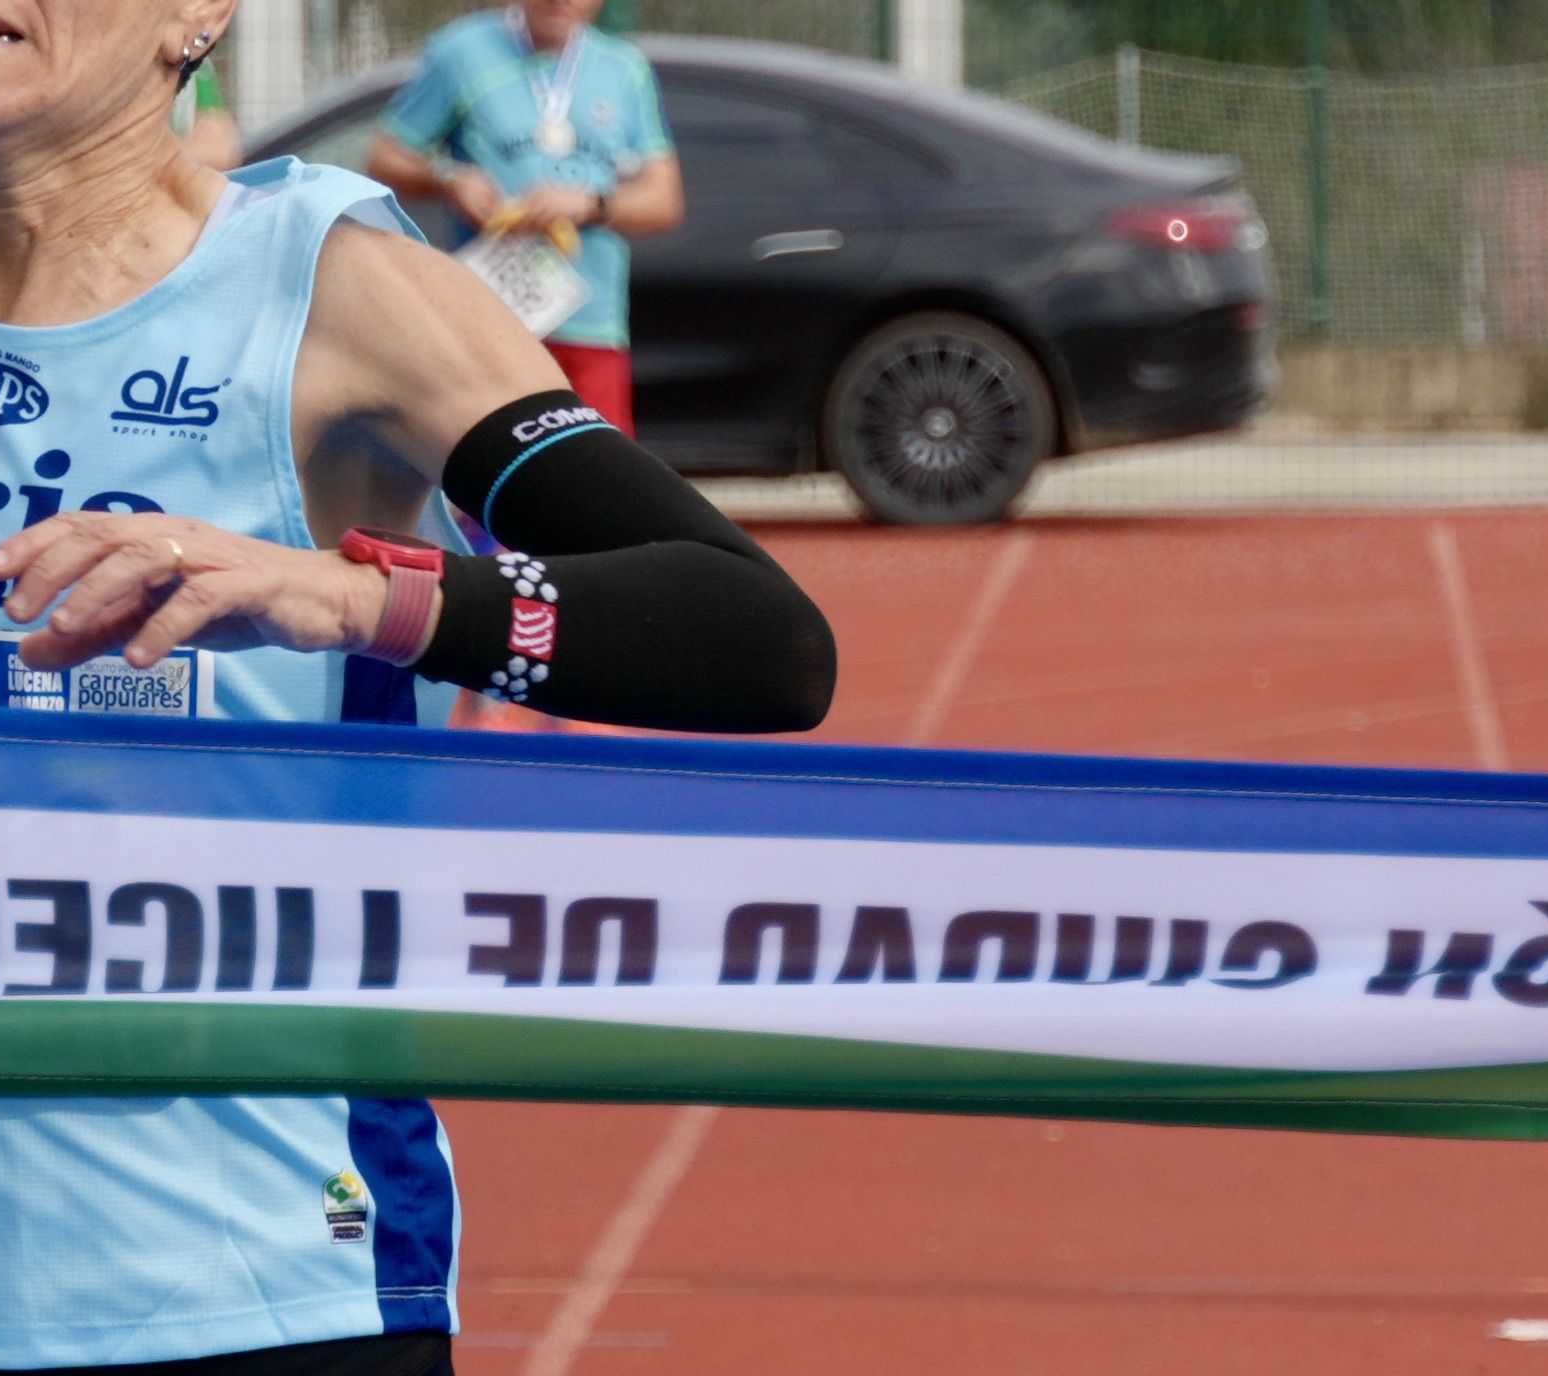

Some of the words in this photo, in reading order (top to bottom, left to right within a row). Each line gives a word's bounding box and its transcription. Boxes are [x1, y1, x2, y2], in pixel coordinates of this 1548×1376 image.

[4, 351, 41, 373] MANGO
[112, 425, 156, 436] sport
[169, 430, 209, 443] shop
[7, 670, 64, 693] LUCENA
[78, 672, 168, 693] carreras
[78, 687, 184, 710] populares
